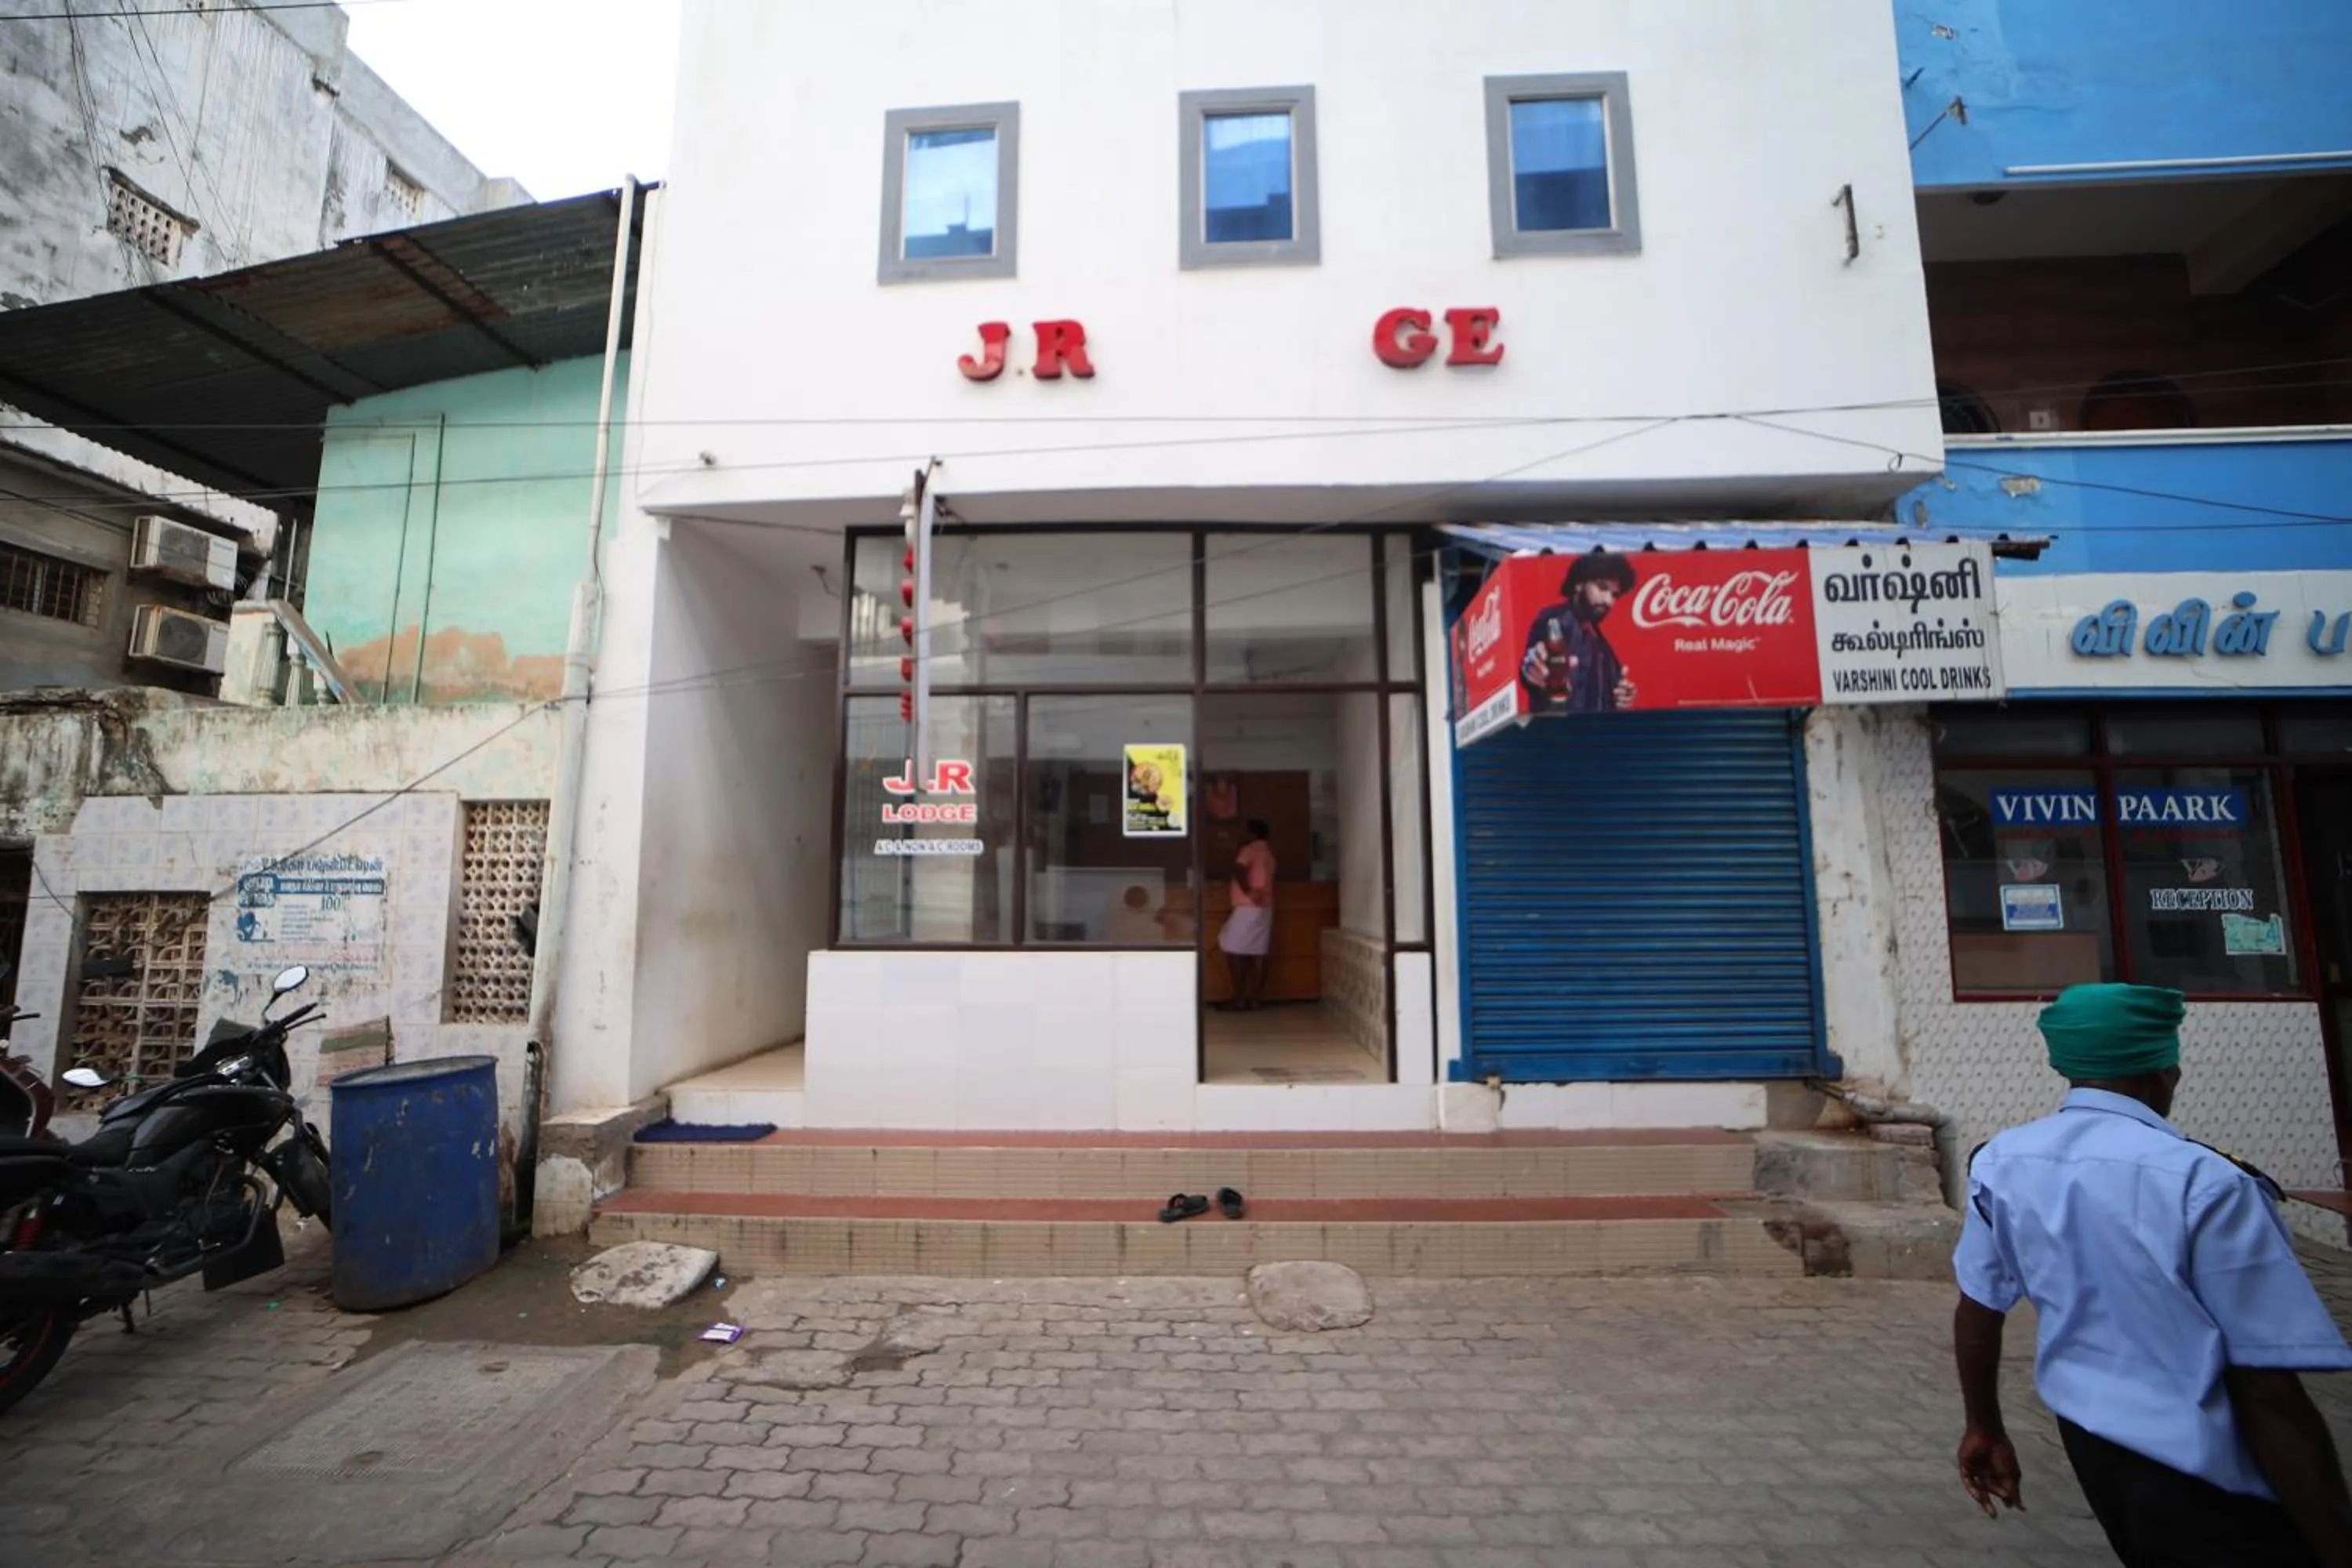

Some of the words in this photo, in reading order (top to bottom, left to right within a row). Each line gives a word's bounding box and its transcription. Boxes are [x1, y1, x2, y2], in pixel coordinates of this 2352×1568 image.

[1632, 570, 1798, 628] Coca-Cola
[2071, 591, 2281, 657] விவின்
[1675, 637, 1708, 652] Real
[1832, 668, 1897, 692] VARSHINI
[1901, 666, 1936, 690] COOL
[1940, 665, 1991, 690] DRINKS
[882, 803, 977, 823] LODGE
[1996, 794, 2096, 822] VIVIN
[2118, 794, 2237, 822] PAARK
[2150, 888, 2254, 910] RECEPTION
